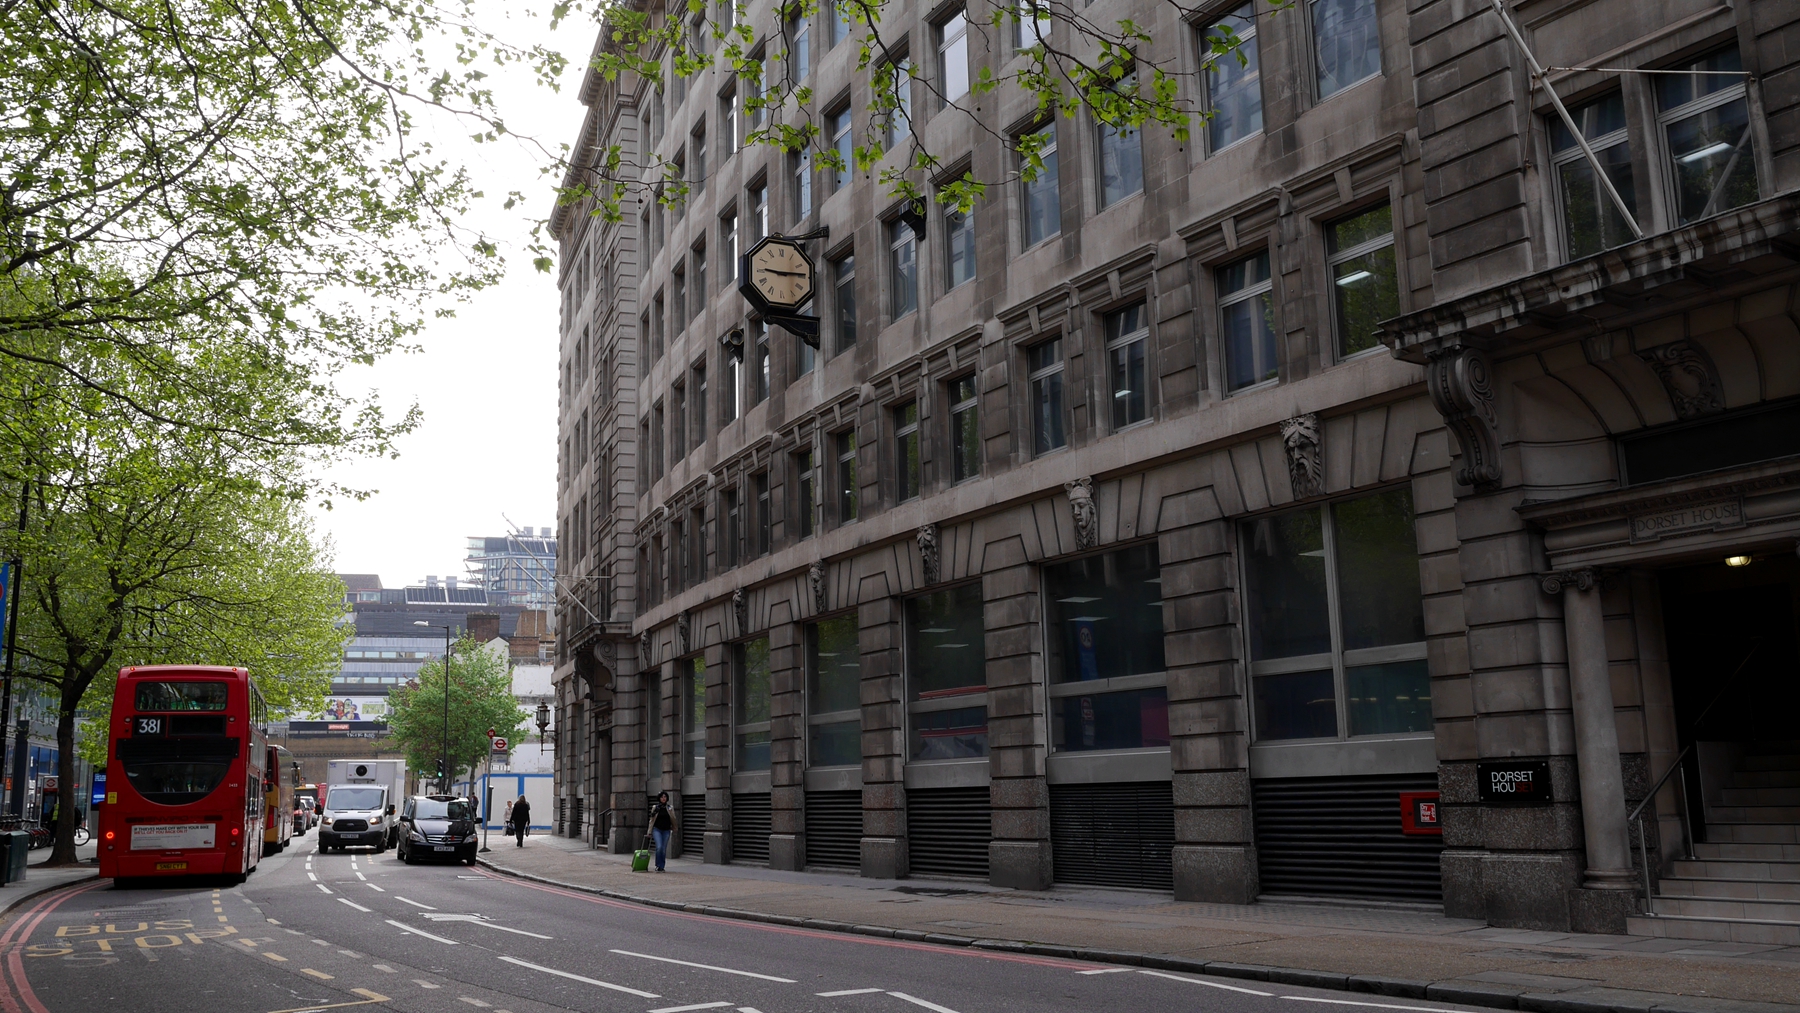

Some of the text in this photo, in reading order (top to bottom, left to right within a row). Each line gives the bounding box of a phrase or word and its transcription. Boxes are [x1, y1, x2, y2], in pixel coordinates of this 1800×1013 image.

[1636, 503, 1739, 532] DORSET HOUSE
[138, 718, 161, 734] 381
[1491, 770, 1534, 782] DORSET
[55, 919, 195, 937] BUS
[26, 929, 230, 957] STOP
